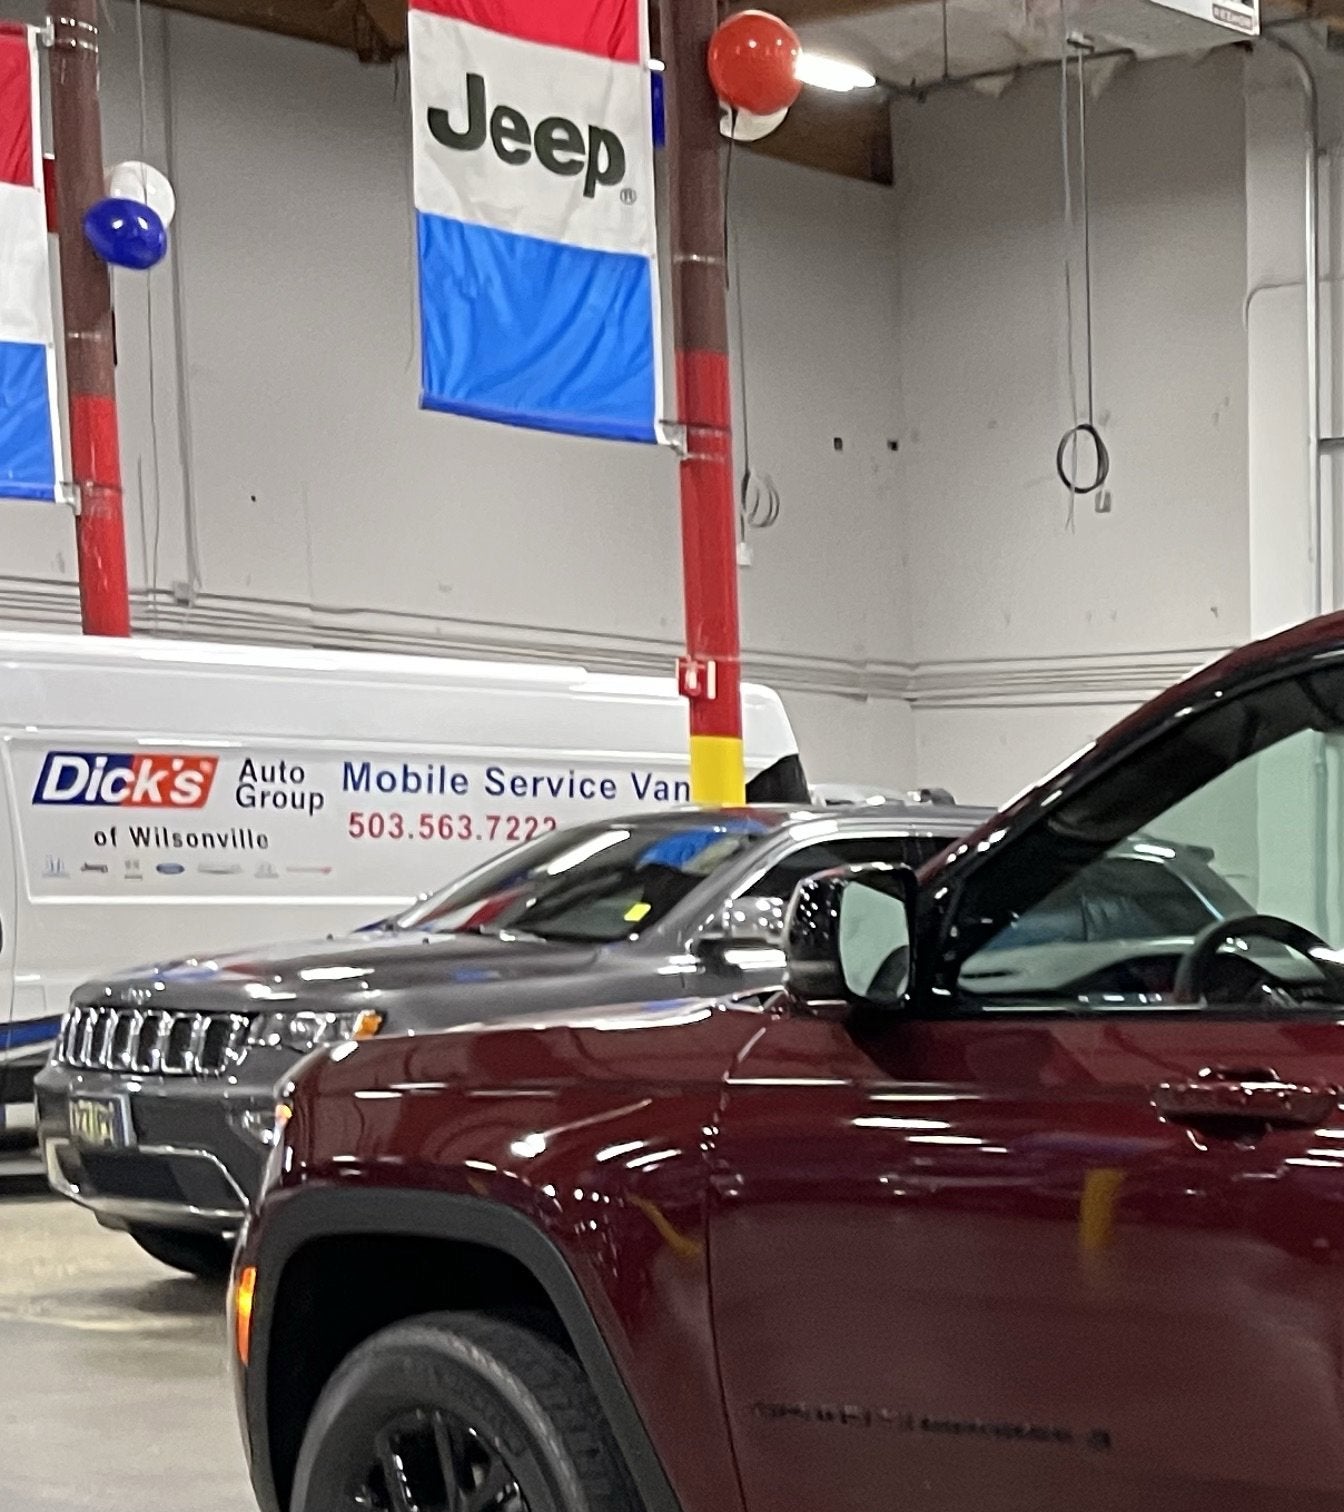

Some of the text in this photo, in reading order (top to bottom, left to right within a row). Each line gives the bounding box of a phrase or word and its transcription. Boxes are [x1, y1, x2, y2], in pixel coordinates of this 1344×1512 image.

[427, 72, 626, 199] Jeep
[42, 755, 204, 804] Dick's
[239, 757, 305, 784] Auto
[343, 761, 690, 802] Mobile Service Van
[236, 783, 325, 815] Group
[94, 826, 269, 849] of Wilsonville
